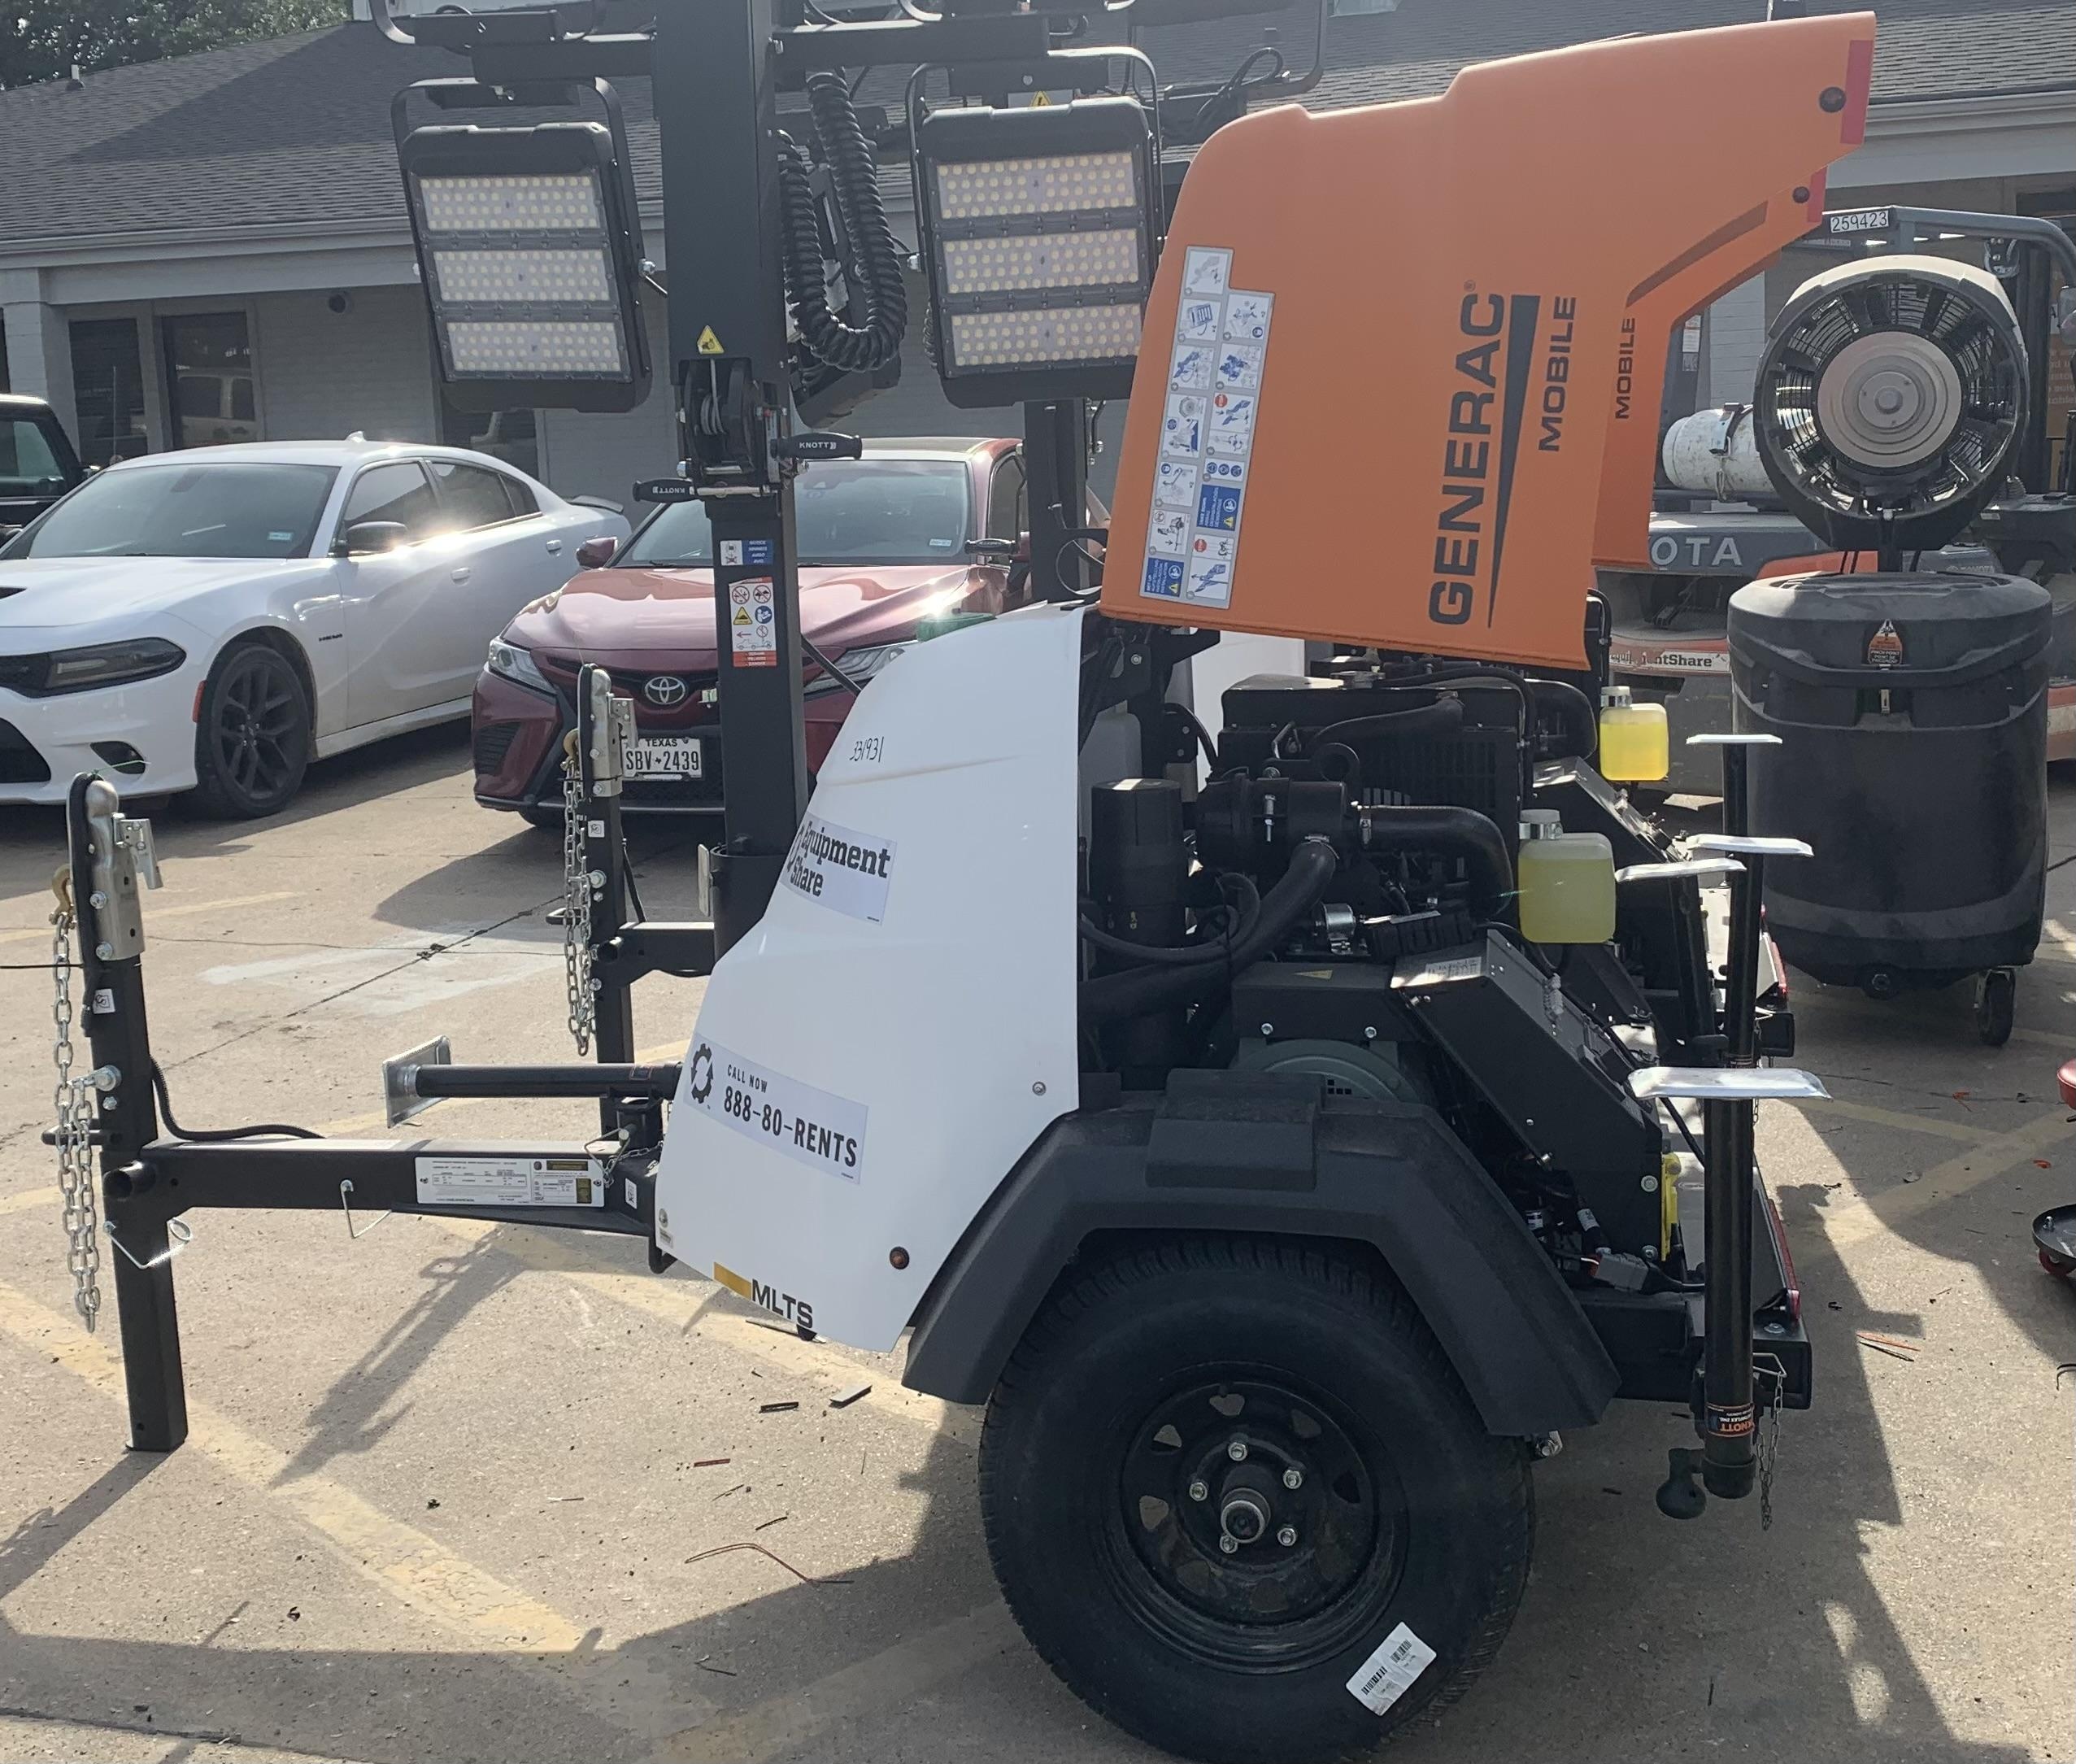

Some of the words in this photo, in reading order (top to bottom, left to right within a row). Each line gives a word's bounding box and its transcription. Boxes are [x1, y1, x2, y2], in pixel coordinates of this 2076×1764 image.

[1831, 211, 1888, 232] 259423
[1538, 296, 1577, 452] MOBILE
[1615, 318, 1636, 420] MOBILE
[1428, 293, 1505, 625] GENERAC
[625, 751, 652, 770] SBV
[663, 751, 699, 770] 2439
[645, 738, 678, 747] TEXAS
[801, 820, 891, 879] Equipment
[790, 855, 824, 897] Share
[727, 1064, 746, 1084] CALL
[749, 1074, 768, 1093] NOW
[723, 1085, 858, 1168] 888-80-RENTS
[751, 1278, 813, 1329] MLTS
[1720, 1421, 1752, 1431] KNOTT
